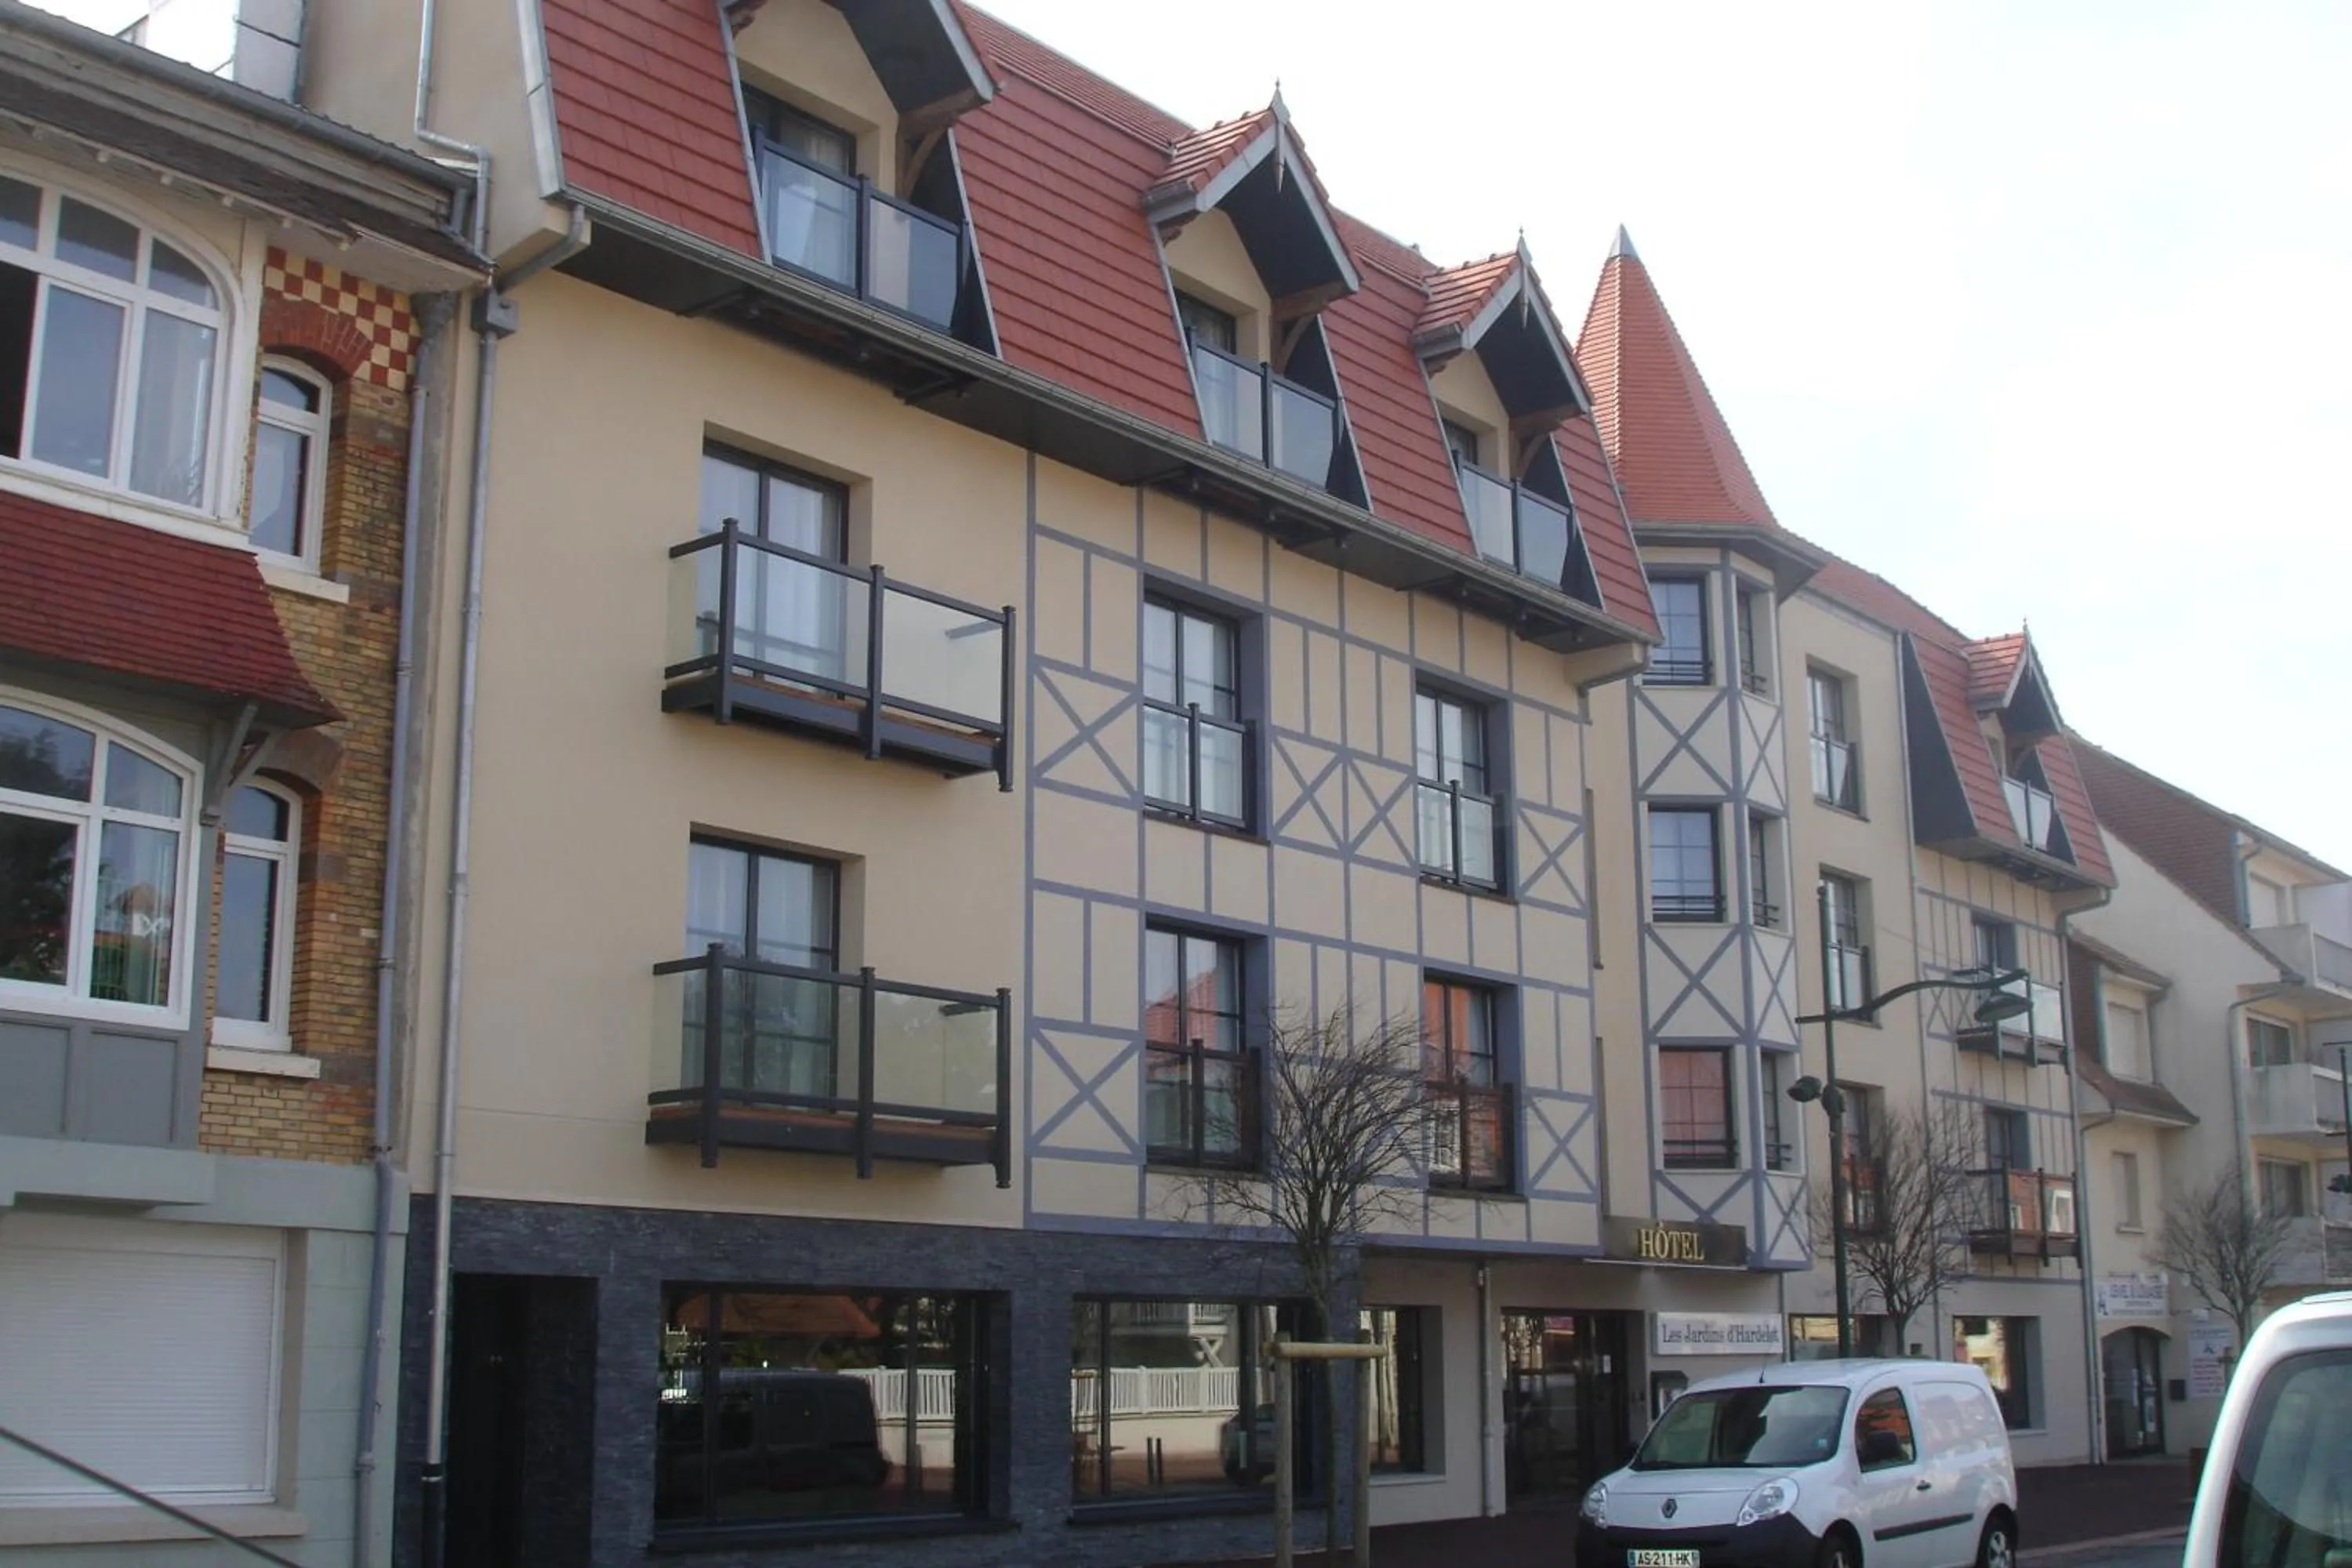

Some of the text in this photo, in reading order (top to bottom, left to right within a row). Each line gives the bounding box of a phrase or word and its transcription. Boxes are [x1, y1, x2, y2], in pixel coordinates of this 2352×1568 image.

[1640, 1221, 1705, 1261] HÔTEL
[1662, 1323, 1682, 1343] Les
[1684, 1323, 1725, 1343] Jardins
